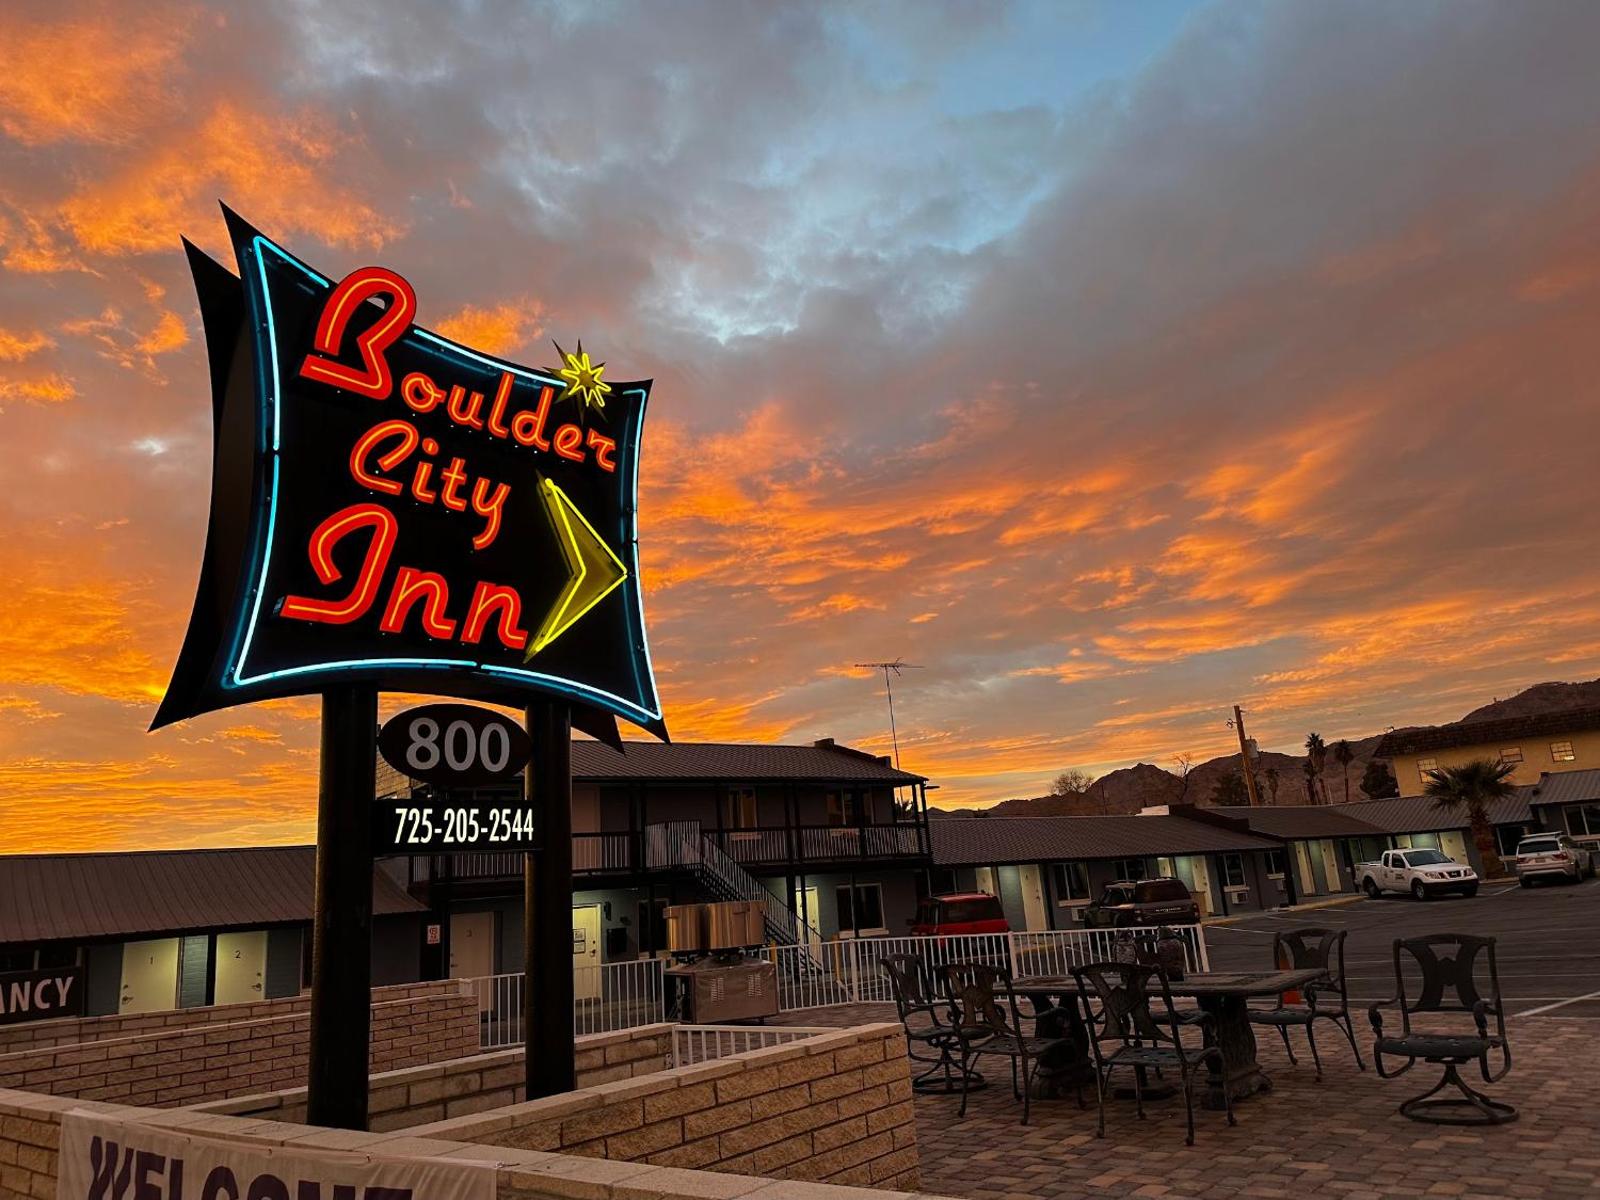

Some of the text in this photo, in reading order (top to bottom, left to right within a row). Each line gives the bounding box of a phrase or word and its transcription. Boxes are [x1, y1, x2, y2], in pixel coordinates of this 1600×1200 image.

[299, 266, 617, 473] Boulder
[349, 419, 512, 551] City
[279, 503, 529, 650] Inn
[406, 717, 511, 773] 800
[394, 807, 534, 844] 725-205-2544
[235, 950, 241, 959] 2
[0, 976, 74, 1014] NCY
